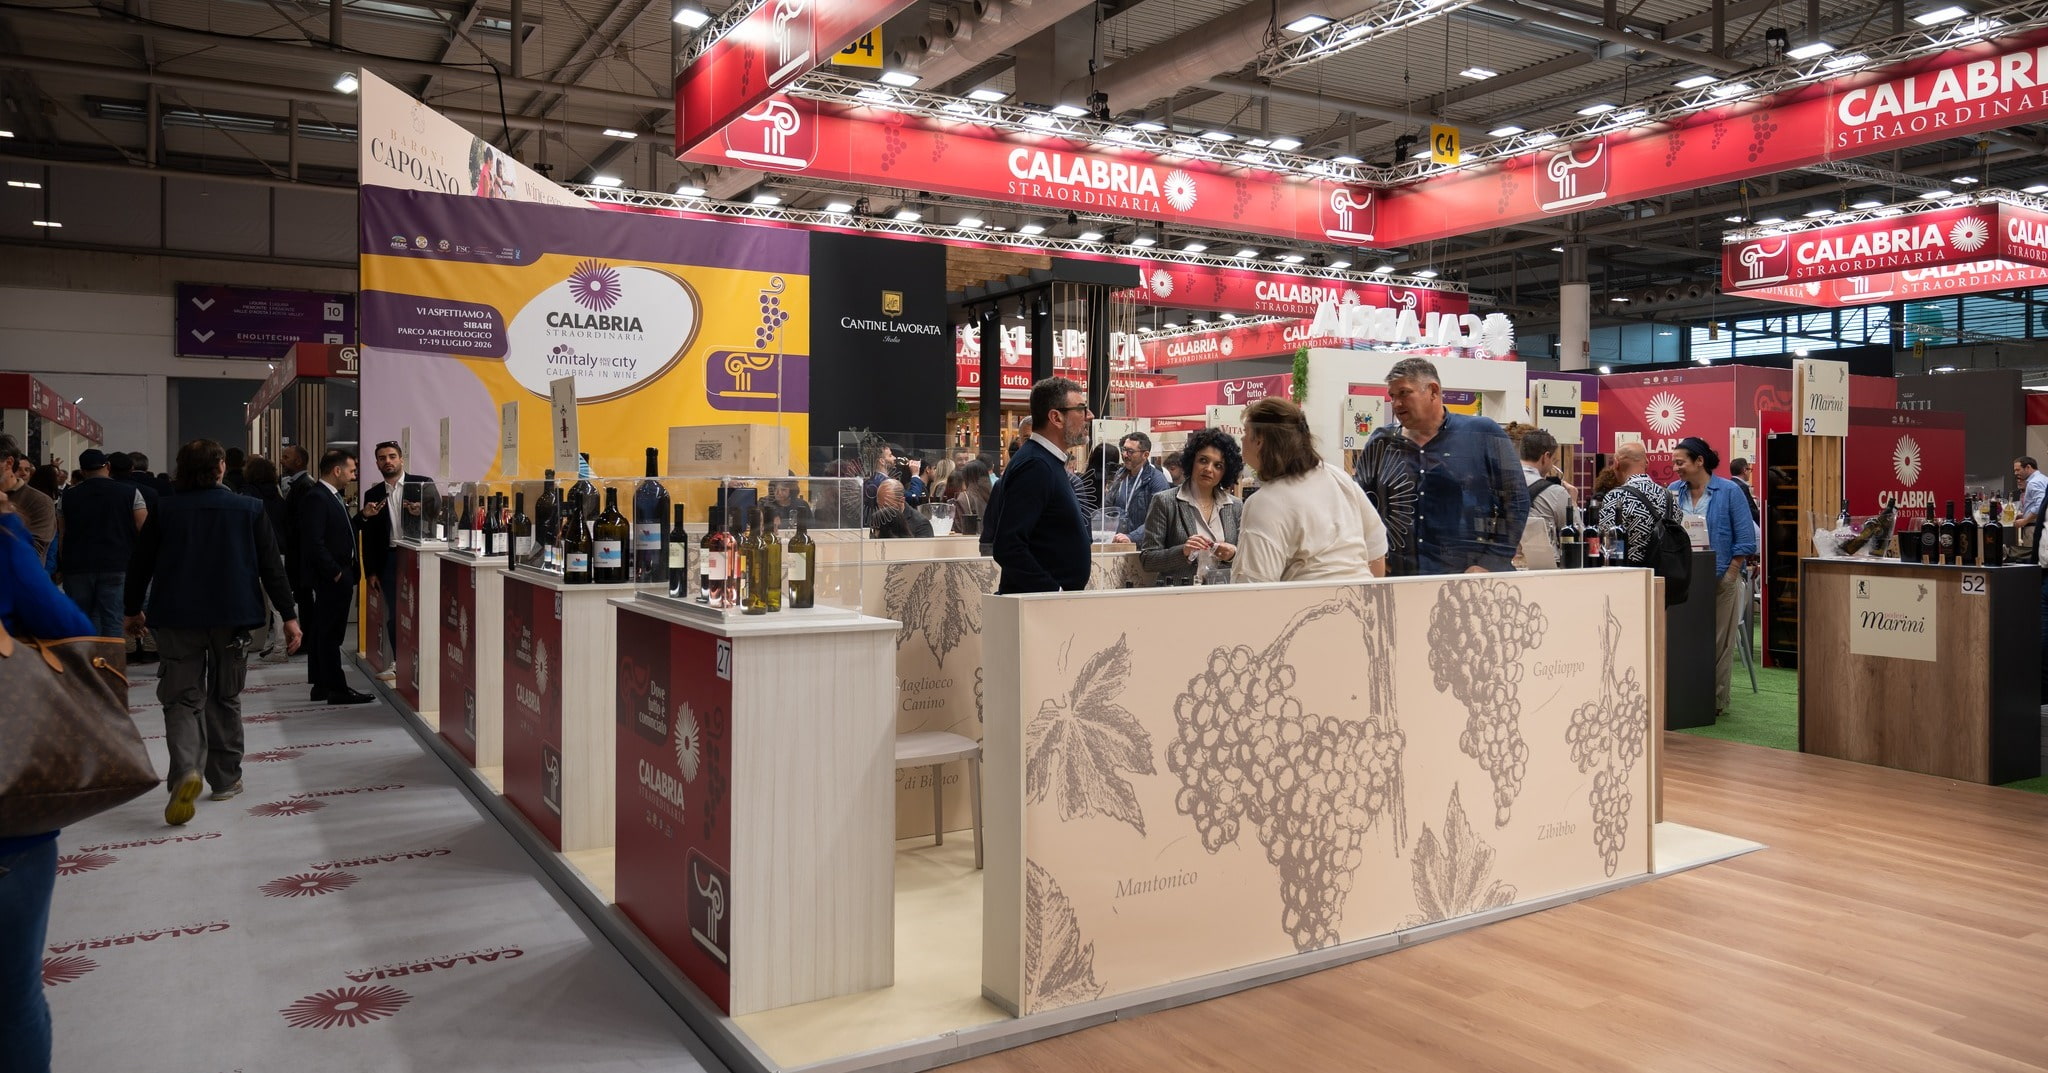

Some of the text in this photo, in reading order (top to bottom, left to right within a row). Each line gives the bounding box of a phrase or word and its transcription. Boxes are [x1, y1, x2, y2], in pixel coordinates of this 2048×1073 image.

[1435, 132, 1455, 157] C4
[1008, 148, 1161, 198] CALABRIA
[1007, 181, 1161, 213] STRAORDINARIA
[1796, 223, 1946, 265] CALABRIA
[1797, 249, 1945, 278] STRAORDINARIA
[1901, 268, 2048, 294] STRAORDINARIA
[1255, 281, 1340, 306] CALABRIA
[327, 306, 341, 317] 10
[416, 307, 426, 315] VI
[428, 308, 485, 319] ASPETTIAMO
[463, 321, 492, 330] SIBARI
[546, 311, 643, 333] CALABRIA
[841, 316, 942, 336] CANTINE LAVORATA
[236, 332, 289, 342] ENOLITECH
[398, 327, 492, 340] PARCO ARCHEOLOGICO
[419, 338, 492, 348] 17-19 LUGLIO 2026
[546, 328, 644, 341] STRAORDINARIA
[1167, 338, 1219, 357] CALABRIA
[546, 353, 598, 369] vinitaly
[612, 356, 637, 371] city
[1166, 353, 1219, 365] STRAORDINARIA
[546, 367, 638, 380] CALABRIA IN WINE
[1002, 374, 1030, 387] tutto
[1246, 381, 1264, 390] Dove
[1246, 388, 1268, 398] tutto è
[1546, 408, 1574, 416] PACELLI
[1809, 392, 1844, 413] Marini
[1804, 418, 1816, 433] 52
[1344, 436, 1355, 448] 50
[1878, 490, 1937, 509] CALABRIA
[1962, 575, 1986, 593] 52
[1860, 610, 1925, 634] Marini
[717, 643, 731, 675] 27
[1533, 659, 1585, 681] Gaglioppo
[650, 680, 666, 701] Dove
[902, 696, 945, 712] Canino
[638, 711, 668, 737] cominciato
[638, 758, 685, 811] CALABRIA
[904, 773, 959, 790] di Bico
[1537, 821, 1577, 841] Zibibbo
[79, 833, 223, 853] CALABRIA
[310, 849, 452, 871] CALABRIA
[1115, 868, 1198, 899] Mantonico
[47, 922, 231, 955] CALABRIA
[345, 949, 525, 983] CALABRIA
